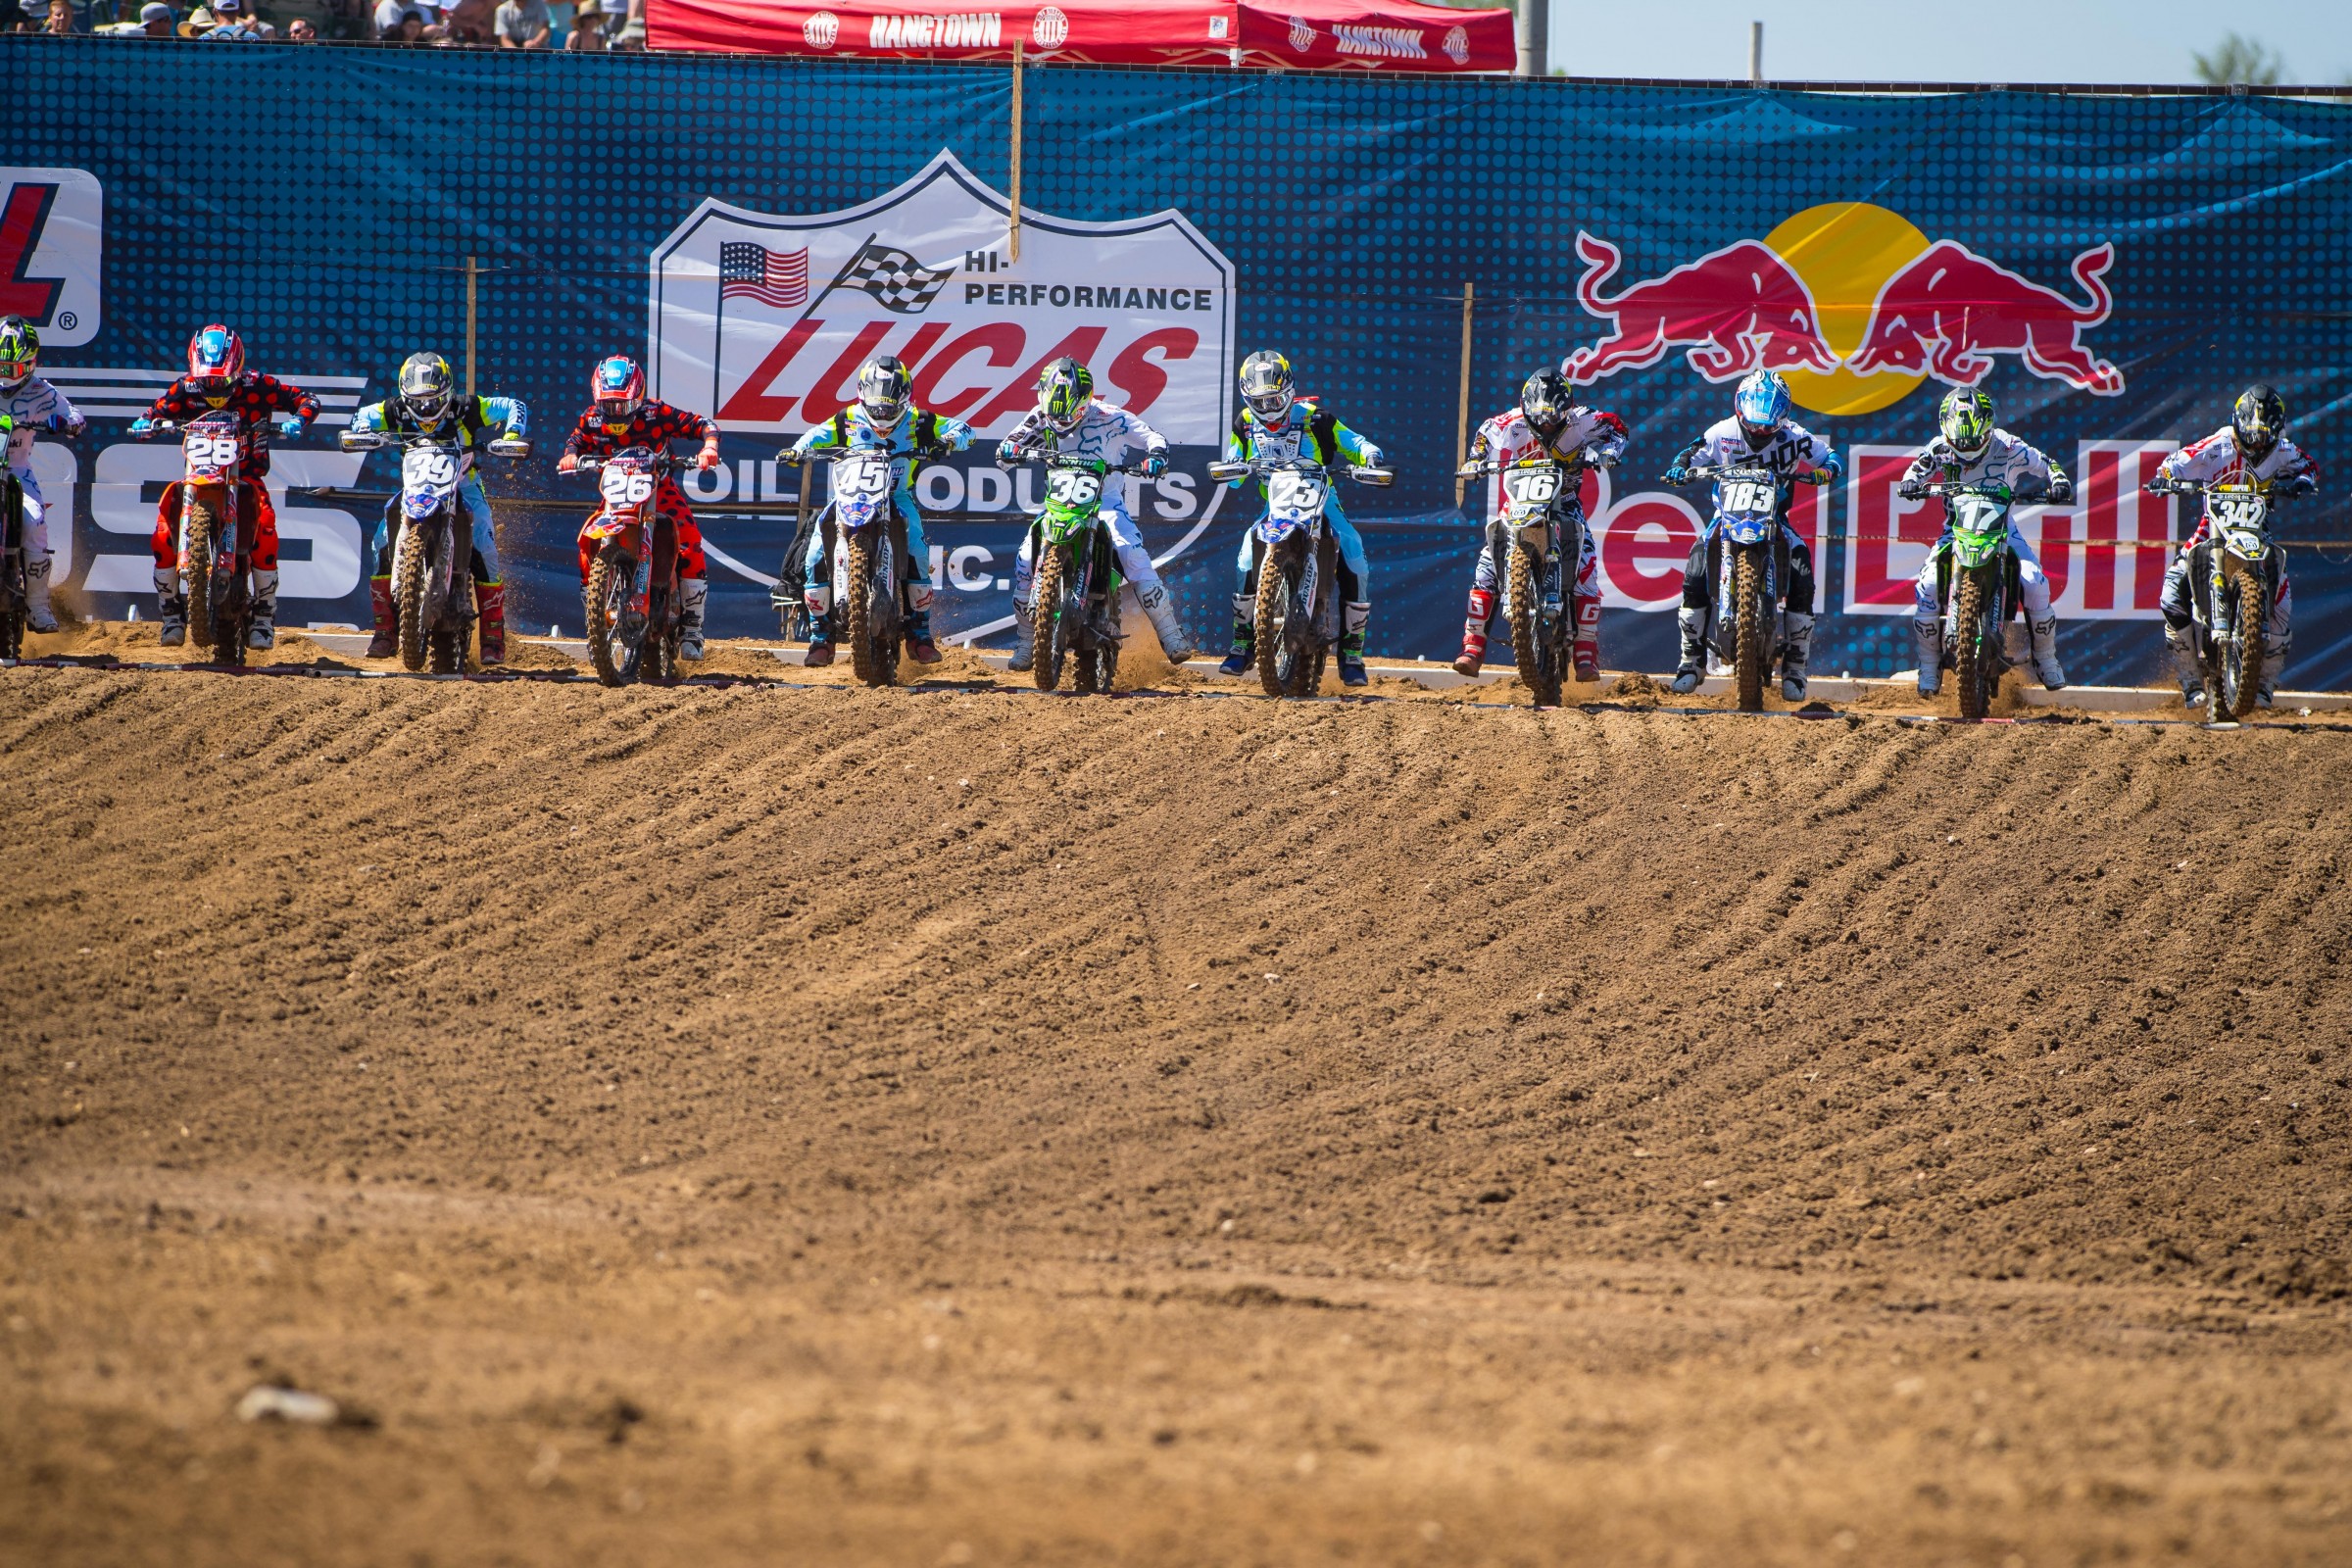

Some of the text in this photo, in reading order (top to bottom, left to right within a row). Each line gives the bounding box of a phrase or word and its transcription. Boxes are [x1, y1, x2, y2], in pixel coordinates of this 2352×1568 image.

[869, 13, 1001, 48] HANGTOWN
[1332, 24, 1428, 59] HANGTOWN
[964, 251, 1008, 272] HI-
[965, 284, 1212, 311] PERFORMANCE
[716, 319, 1199, 428] LUCAS
[186, 437, 237, 466] 28
[1735, 435, 1813, 470] THOR
[407, 454, 455, 485] 39
[838, 462, 886, 494] 45
[603, 473, 653, 504] 26
[683, 460, 800, 520] OIL
[1050, 473, 1100, 505] 36
[1273, 476, 1320, 508] 23
[1512, 474, 1555, 502] 16
[1723, 482, 1775, 513] 183
[1960, 500, 2008, 531] 17
[2218, 500, 2263, 529] 342
[881, 545, 890, 586] DUNLOP
[1301, 563, 1314, 606] DUNLOP
[1990, 591, 2001, 633] DUNLOP
